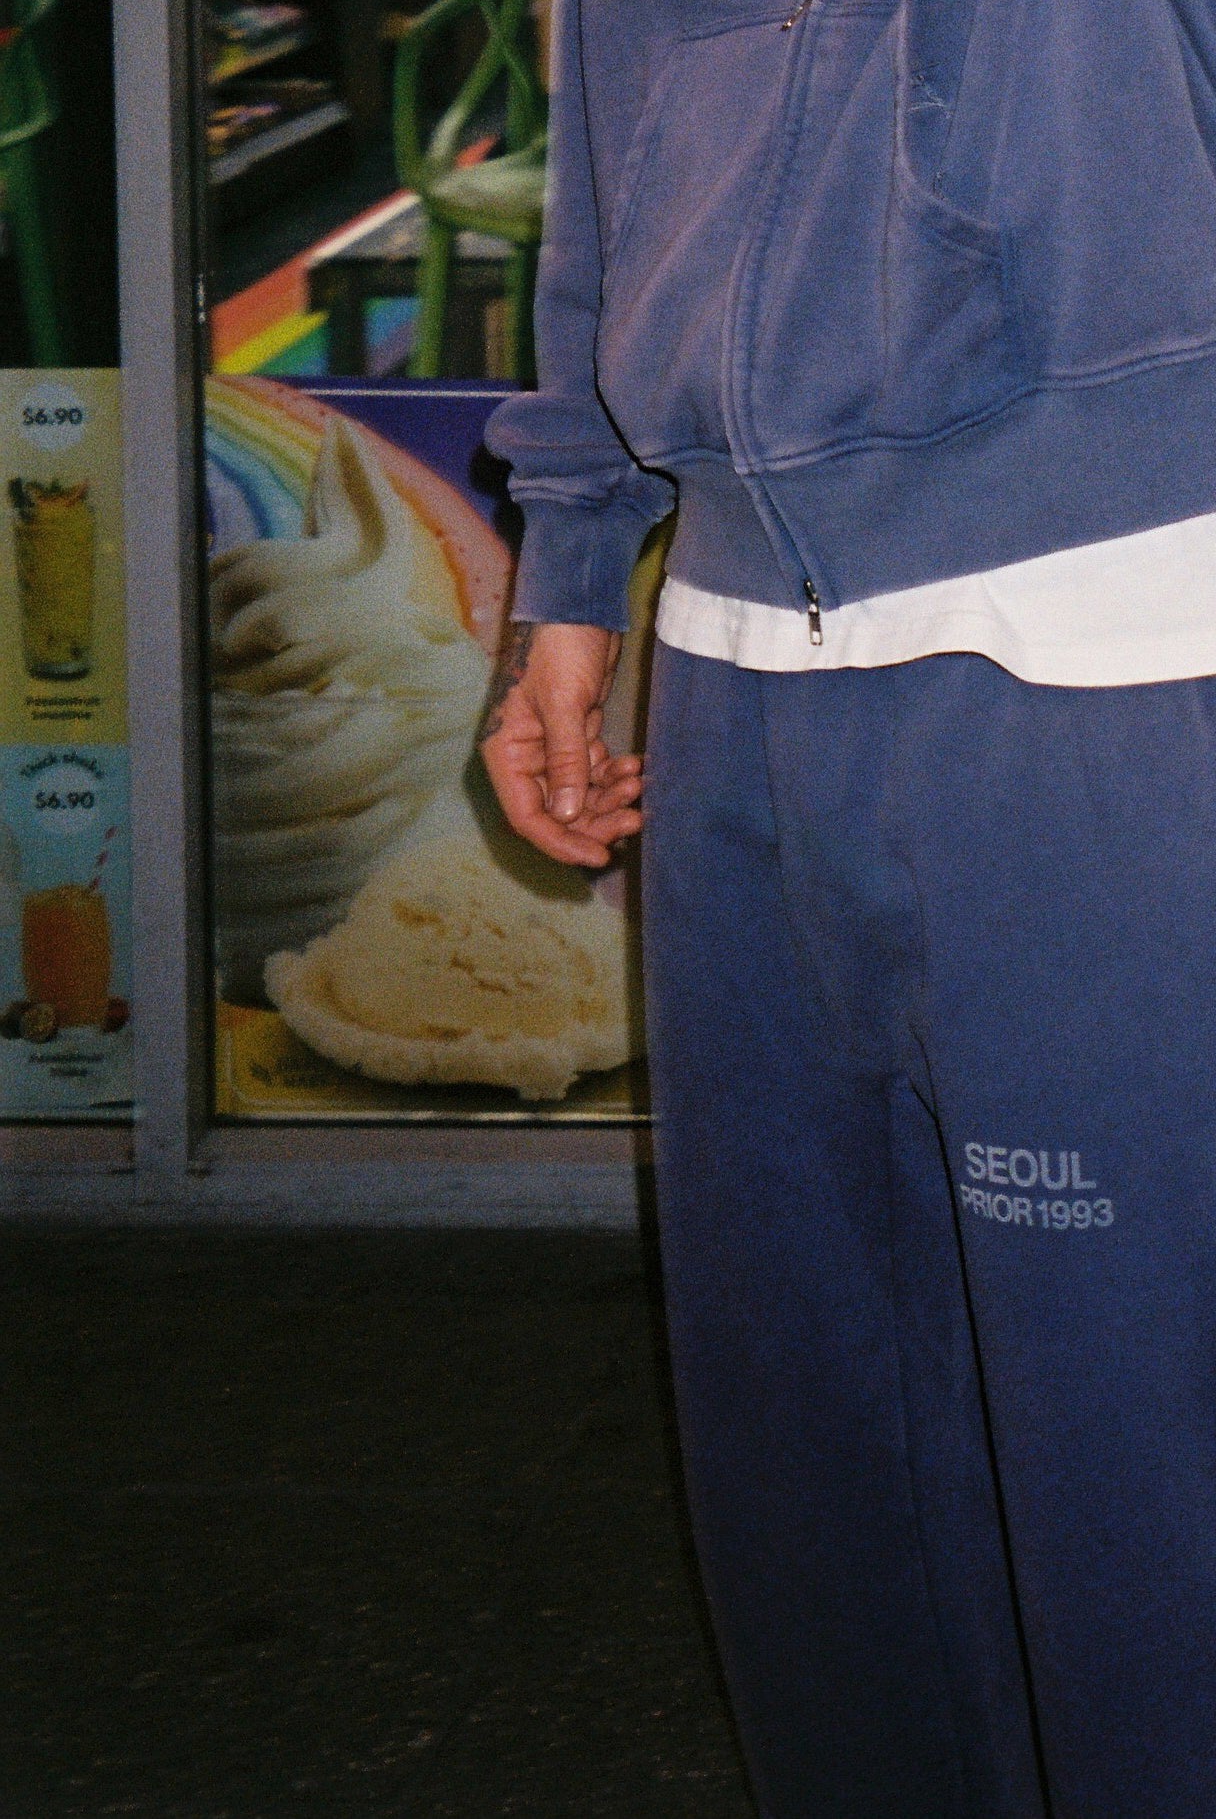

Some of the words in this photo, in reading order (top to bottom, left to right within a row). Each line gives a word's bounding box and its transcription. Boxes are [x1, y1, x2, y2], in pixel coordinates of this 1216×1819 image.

[22, 407, 84, 427] $6.90
[34, 791, 96, 810] $6.90
[964, 1142, 1097, 1190] SEOUL
[960, 1183, 1034, 1227] PRIOR
[1037, 1197, 1115, 1230] 1993
